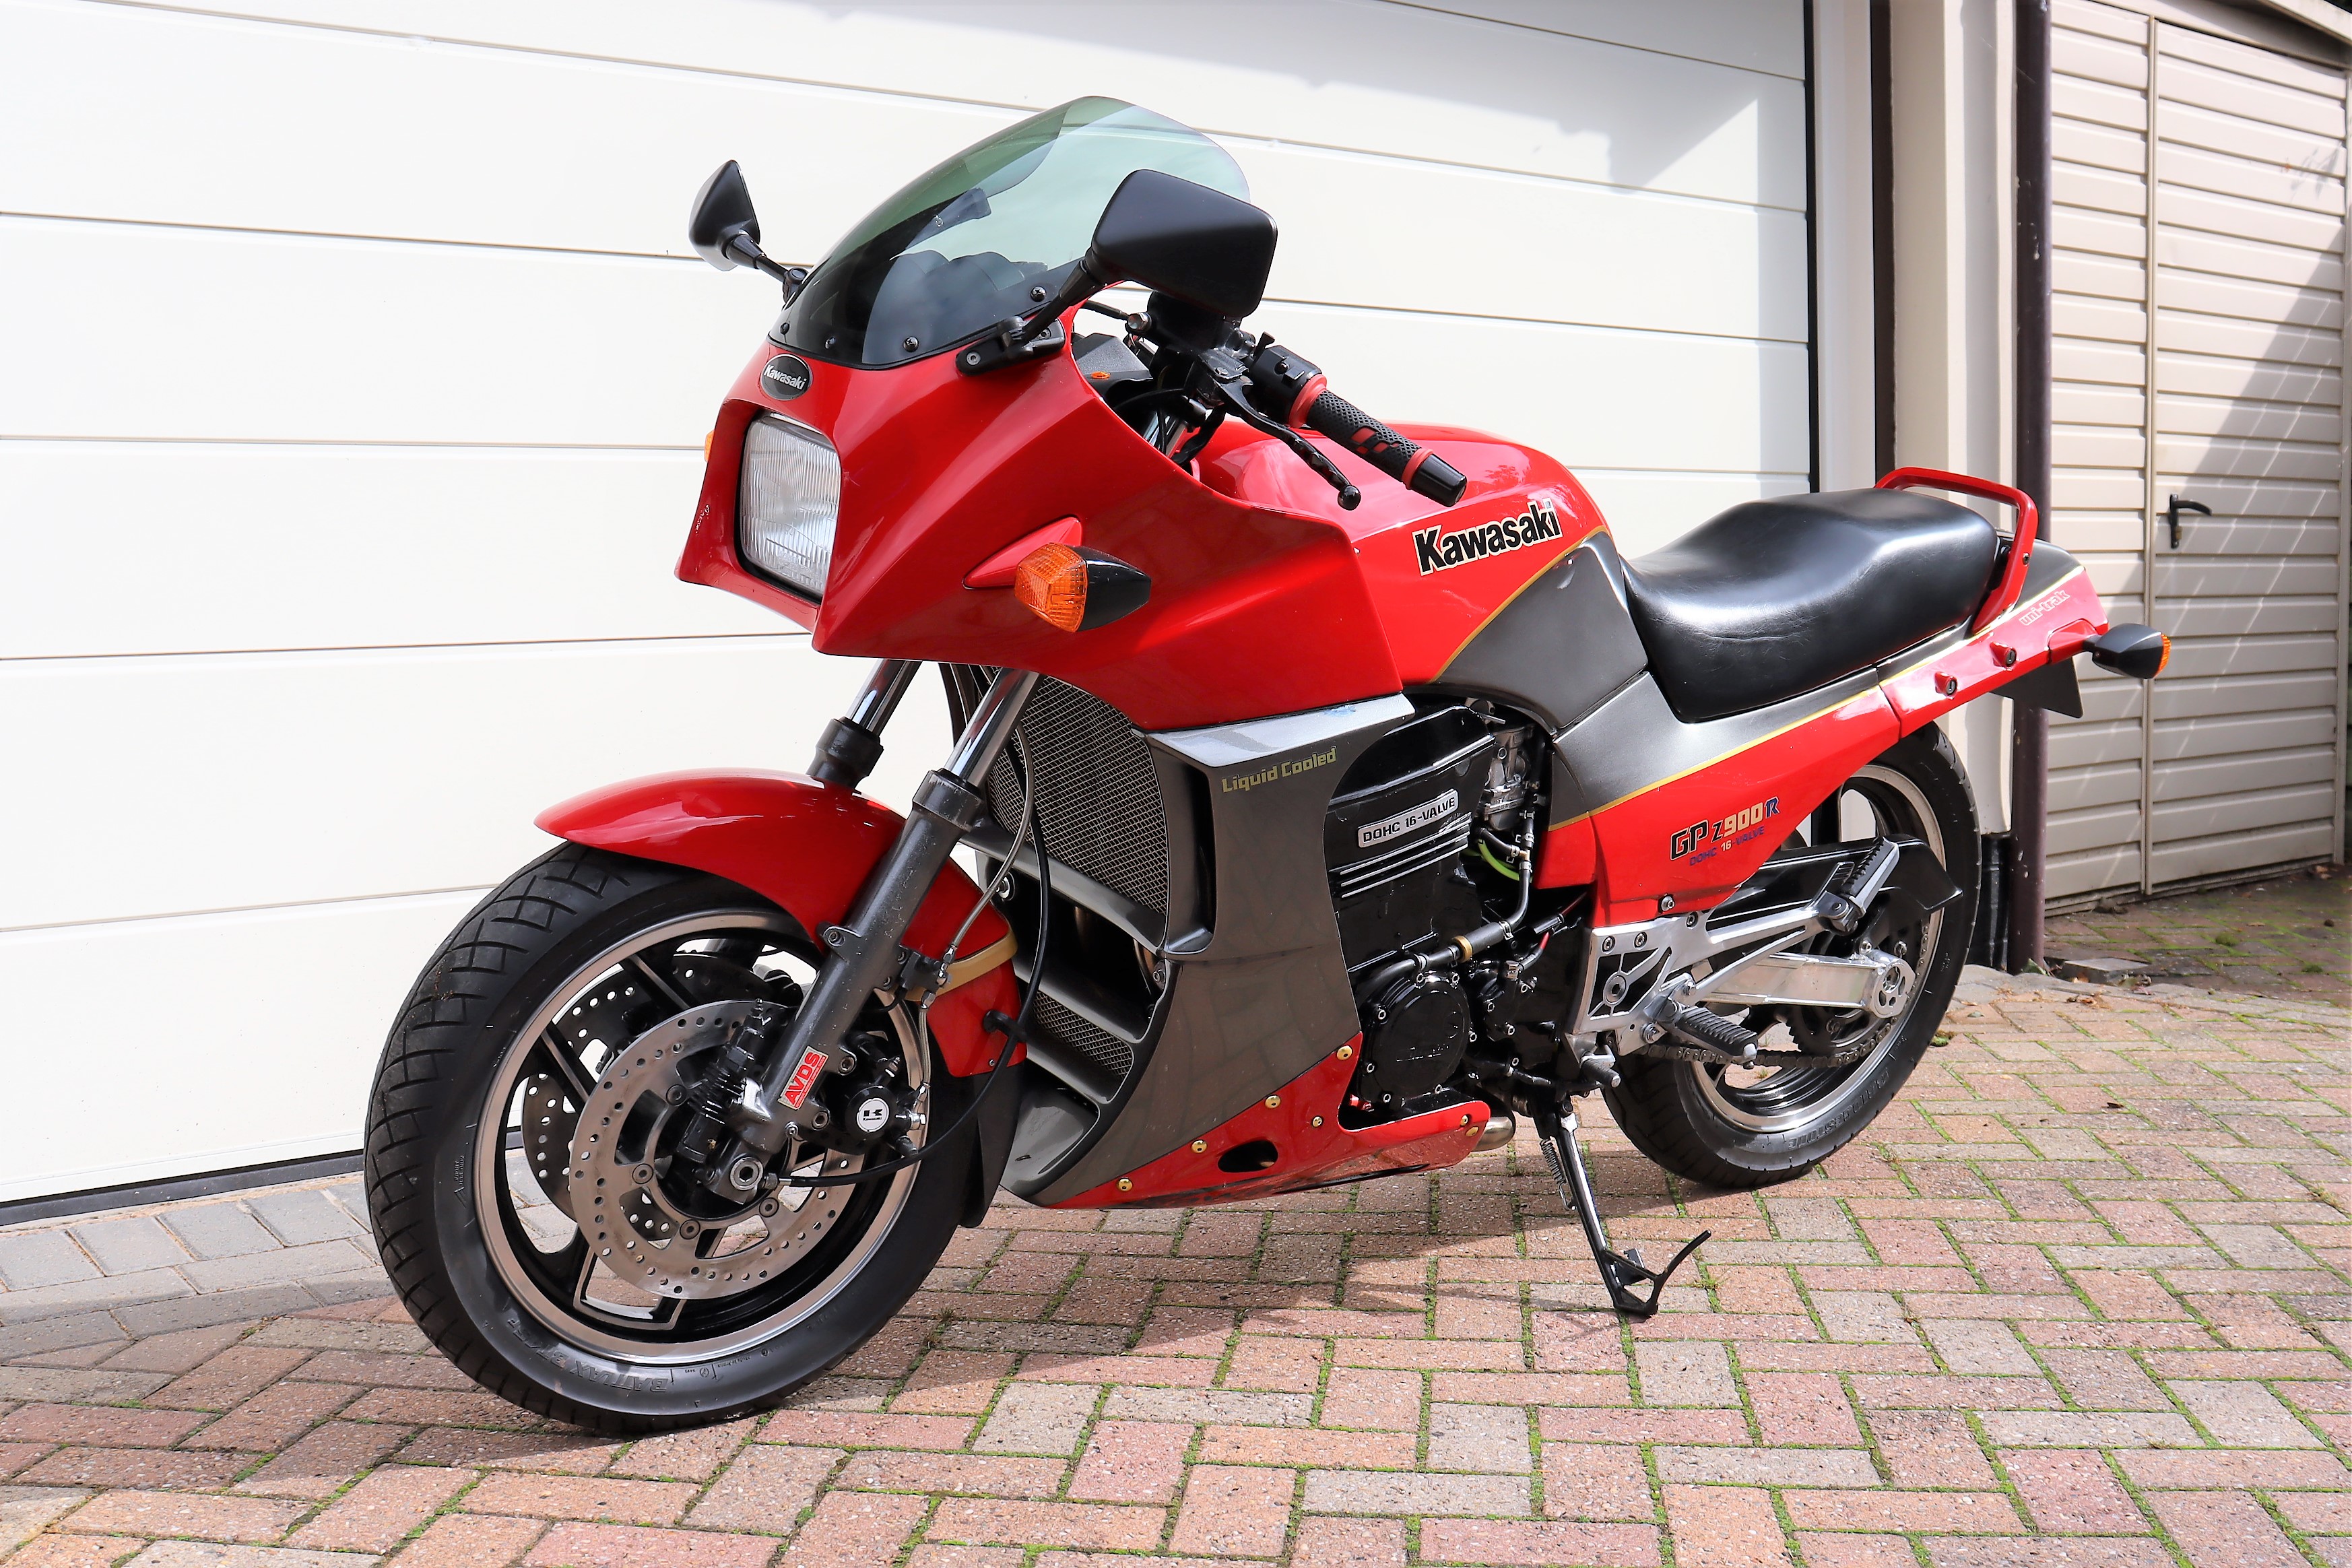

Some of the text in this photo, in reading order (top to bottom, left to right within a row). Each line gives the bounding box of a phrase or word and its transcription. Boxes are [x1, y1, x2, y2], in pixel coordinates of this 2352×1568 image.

[763, 364, 807, 390] Kawasaki
[1414, 498, 1561, 574] Kawasaki
[2019, 589, 2070, 625] uni-trak
[1222, 746, 1337, 792] Liquid Cooled
[1362, 796, 1456, 843] DOHC 16-VALVE
[1689, 826, 1765, 865] DOHC 16-VALVE
[784, 1051, 820, 1106] AVDS
